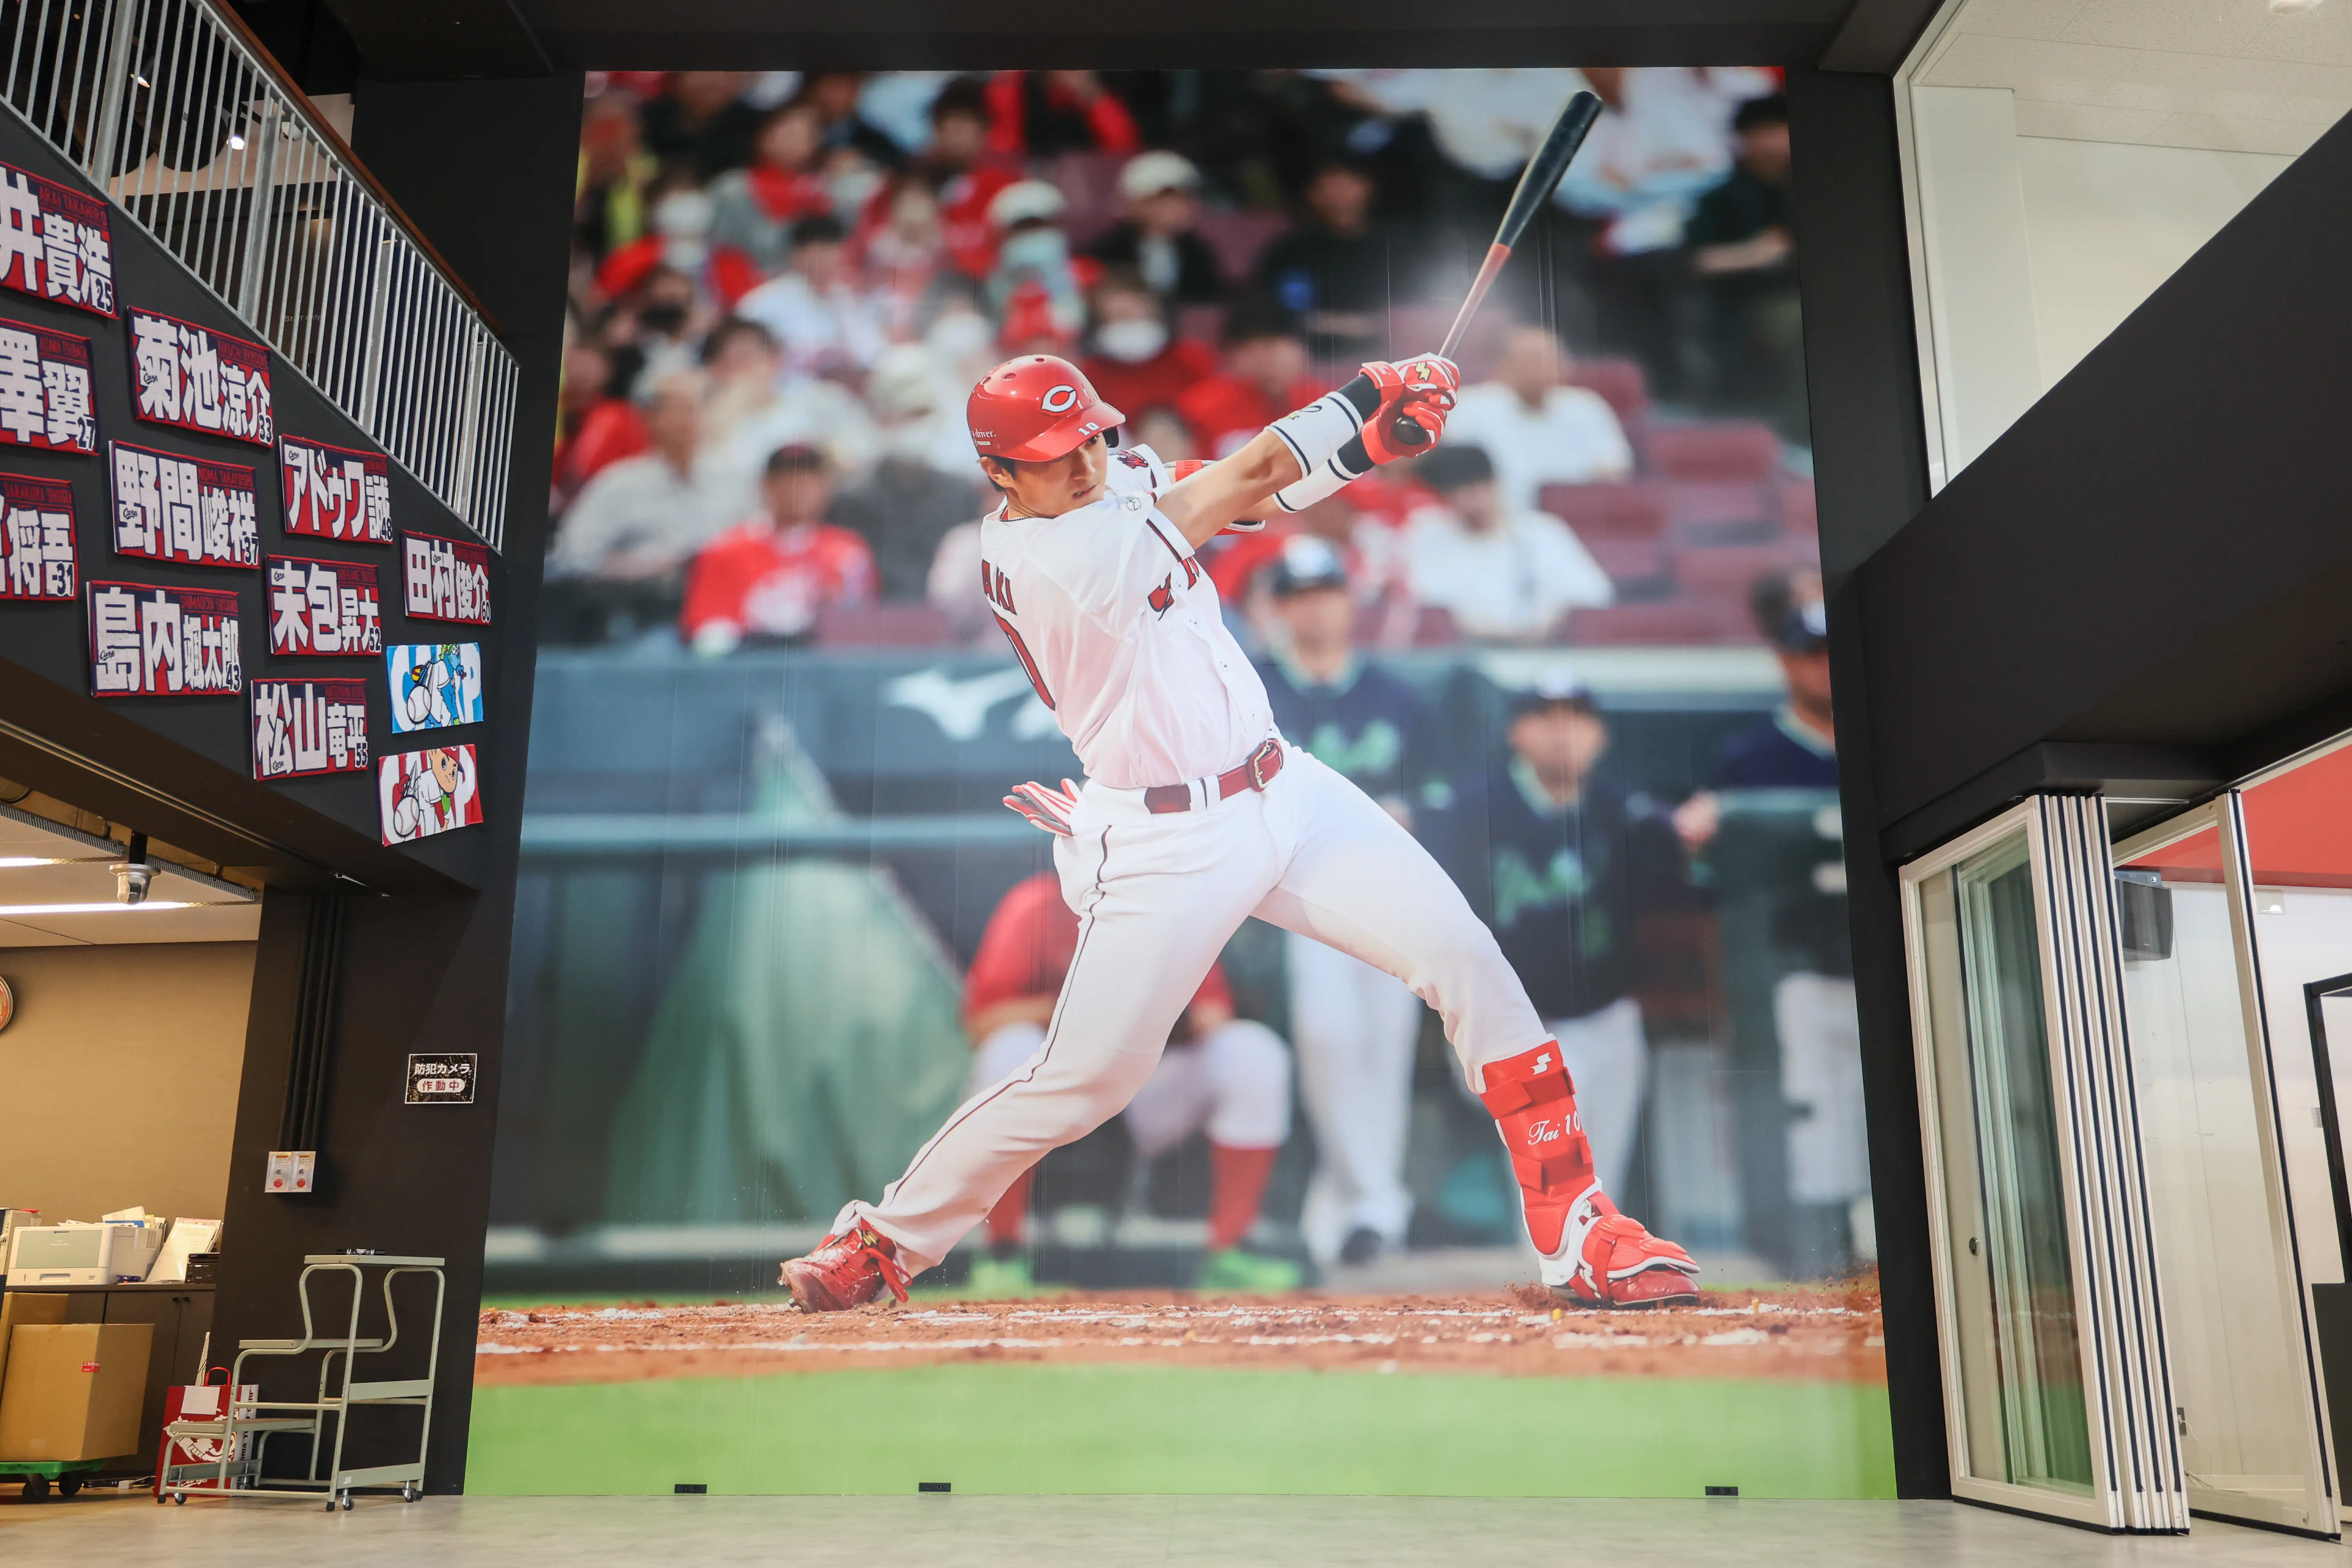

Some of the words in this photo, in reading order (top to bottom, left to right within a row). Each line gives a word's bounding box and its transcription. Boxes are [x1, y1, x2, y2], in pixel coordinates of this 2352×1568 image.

[40, 185, 62, 208] ARAI
[63, 194, 107, 226] TAKAHIRO
[96, 280, 113, 314] 25
[134, 315, 270, 438] 菊池涼介
[143, 373, 158, 385] Carp
[77, 417, 95, 451] 27
[259, 413, 273, 445] 33
[975, 428, 996, 437] driver.
[1078, 422, 1100, 436] 10
[198, 467, 218, 483] NOMA
[123, 508, 138, 519] Carp
[381, 517, 392, 541] 48
[244, 536, 259, 565] 37
[56, 561, 74, 596] 31
[271, 561, 378, 652] 末包昇大
[481, 600, 491, 622] 60
[368, 626, 382, 653] 52
[100, 650, 115, 661] Carp
[226, 662, 241, 692] 43
[256, 683, 366, 776] 松山竜平
[354, 740, 368, 768] 55
[414, 1063, 470, 1075] 防犯カメラ
[422, 1080, 459, 1091] 作動中
[1527, 1119, 1560, 1145] Tai
[1564, 1110, 1580, 1135] 10
